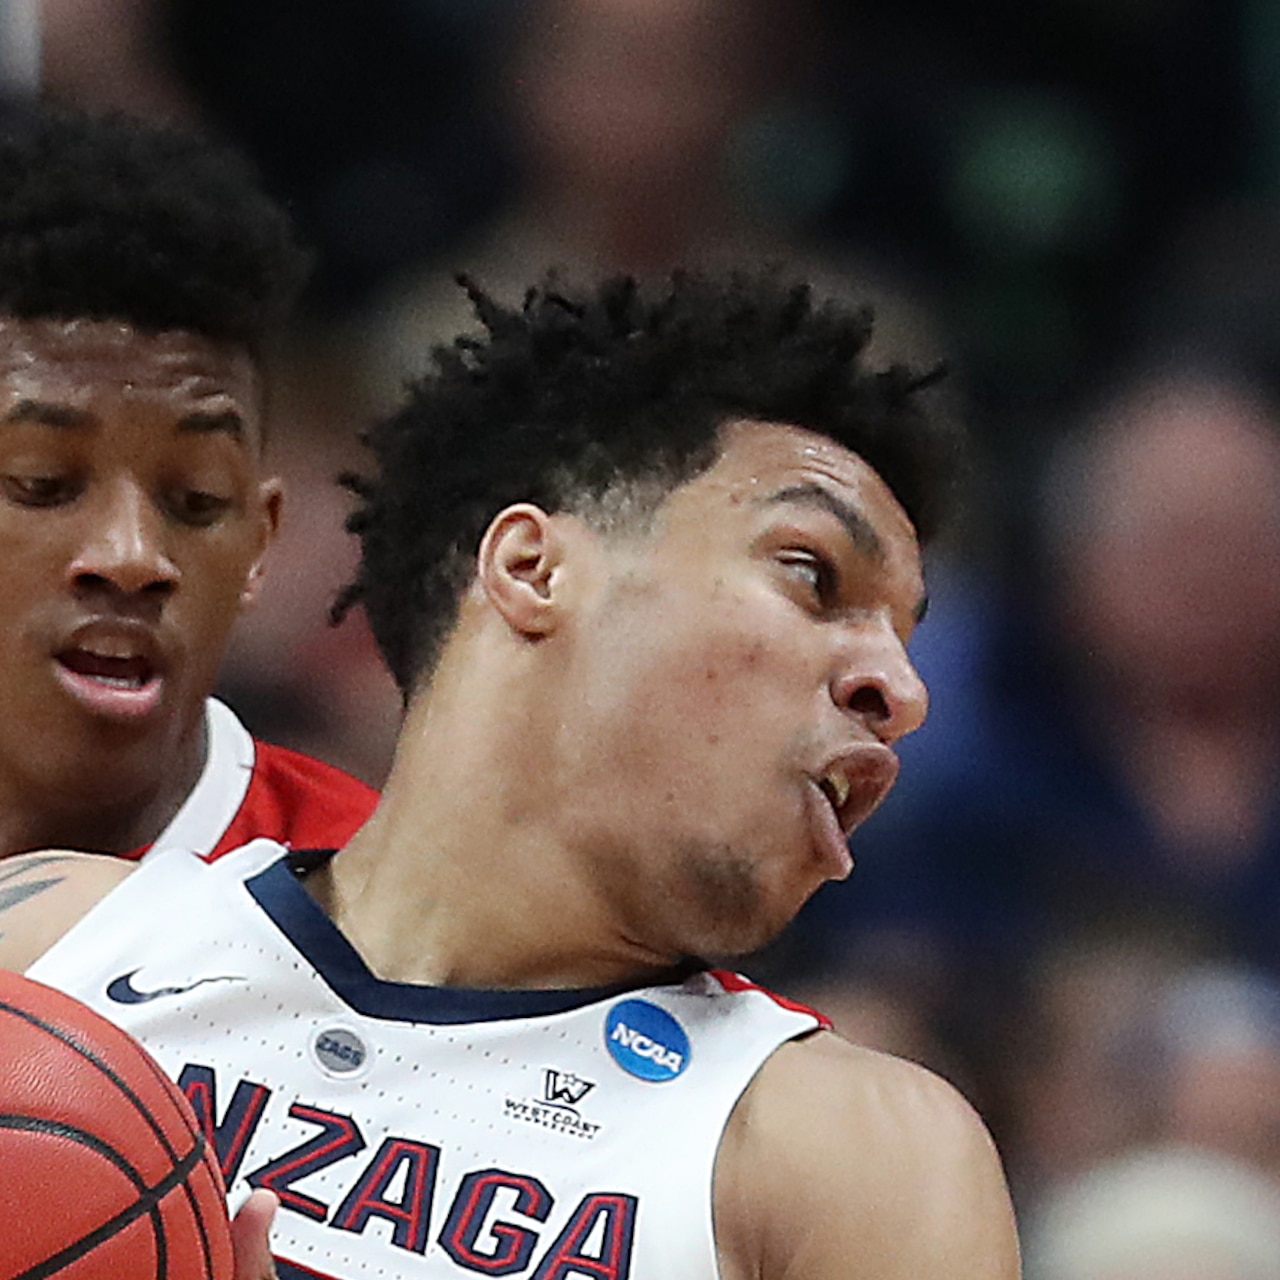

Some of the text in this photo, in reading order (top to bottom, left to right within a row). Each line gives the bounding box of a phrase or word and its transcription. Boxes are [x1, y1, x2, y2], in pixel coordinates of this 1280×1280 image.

[316, 1035, 365, 1067] ZAGS
[609, 1022, 683, 1074] NCAA
[504, 1098, 602, 1134] WEST COAST
